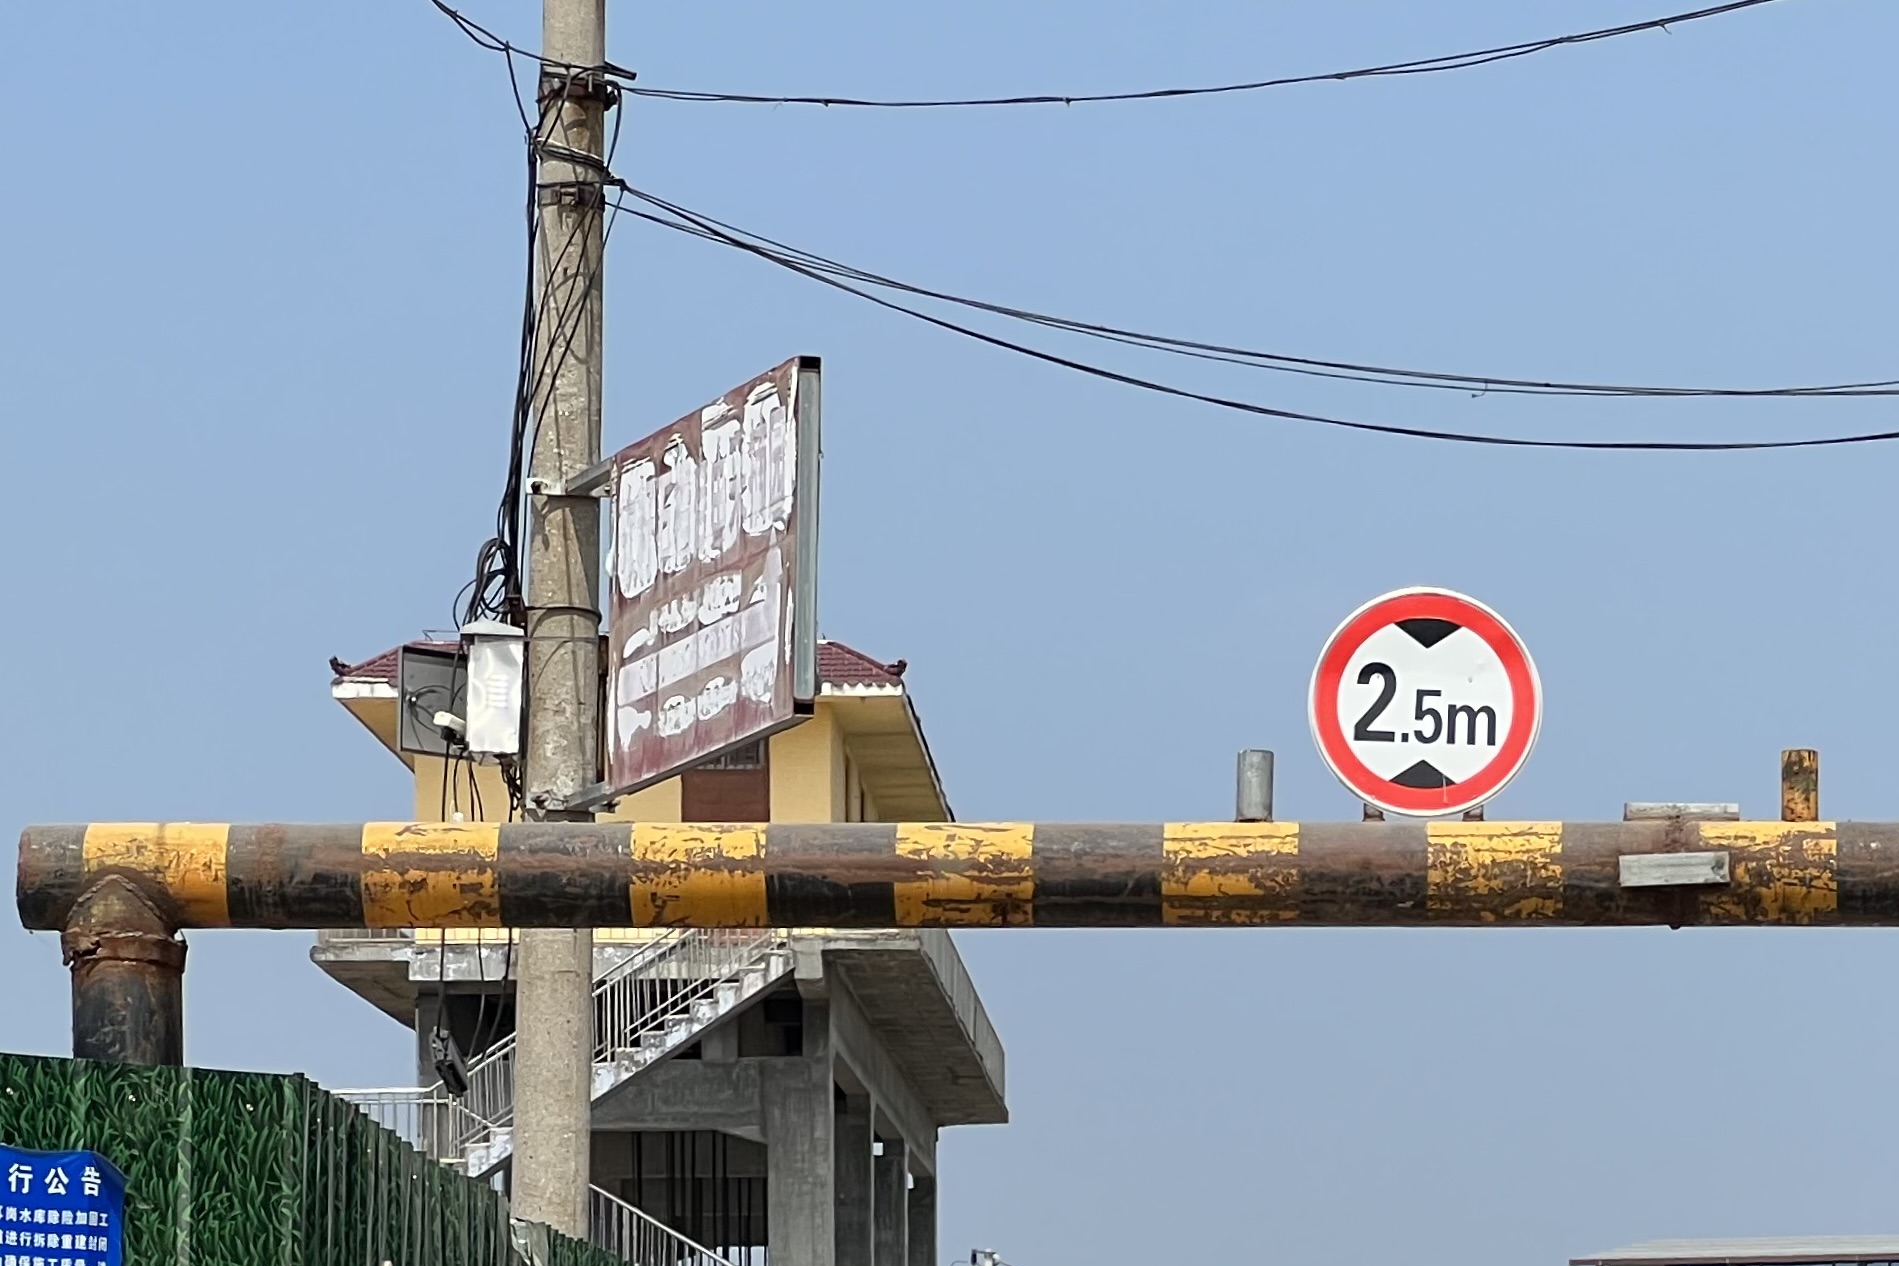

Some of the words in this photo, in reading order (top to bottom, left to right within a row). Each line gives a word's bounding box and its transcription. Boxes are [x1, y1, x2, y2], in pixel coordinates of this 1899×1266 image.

[1353, 661, 1497, 746] 2.5m
[7, 1163, 102, 1197] 行公告
[0, 1205, 109, 1228] 岗水库除险加固工
[0, 1229, 108, 1252] 进行拆除重建封闭
